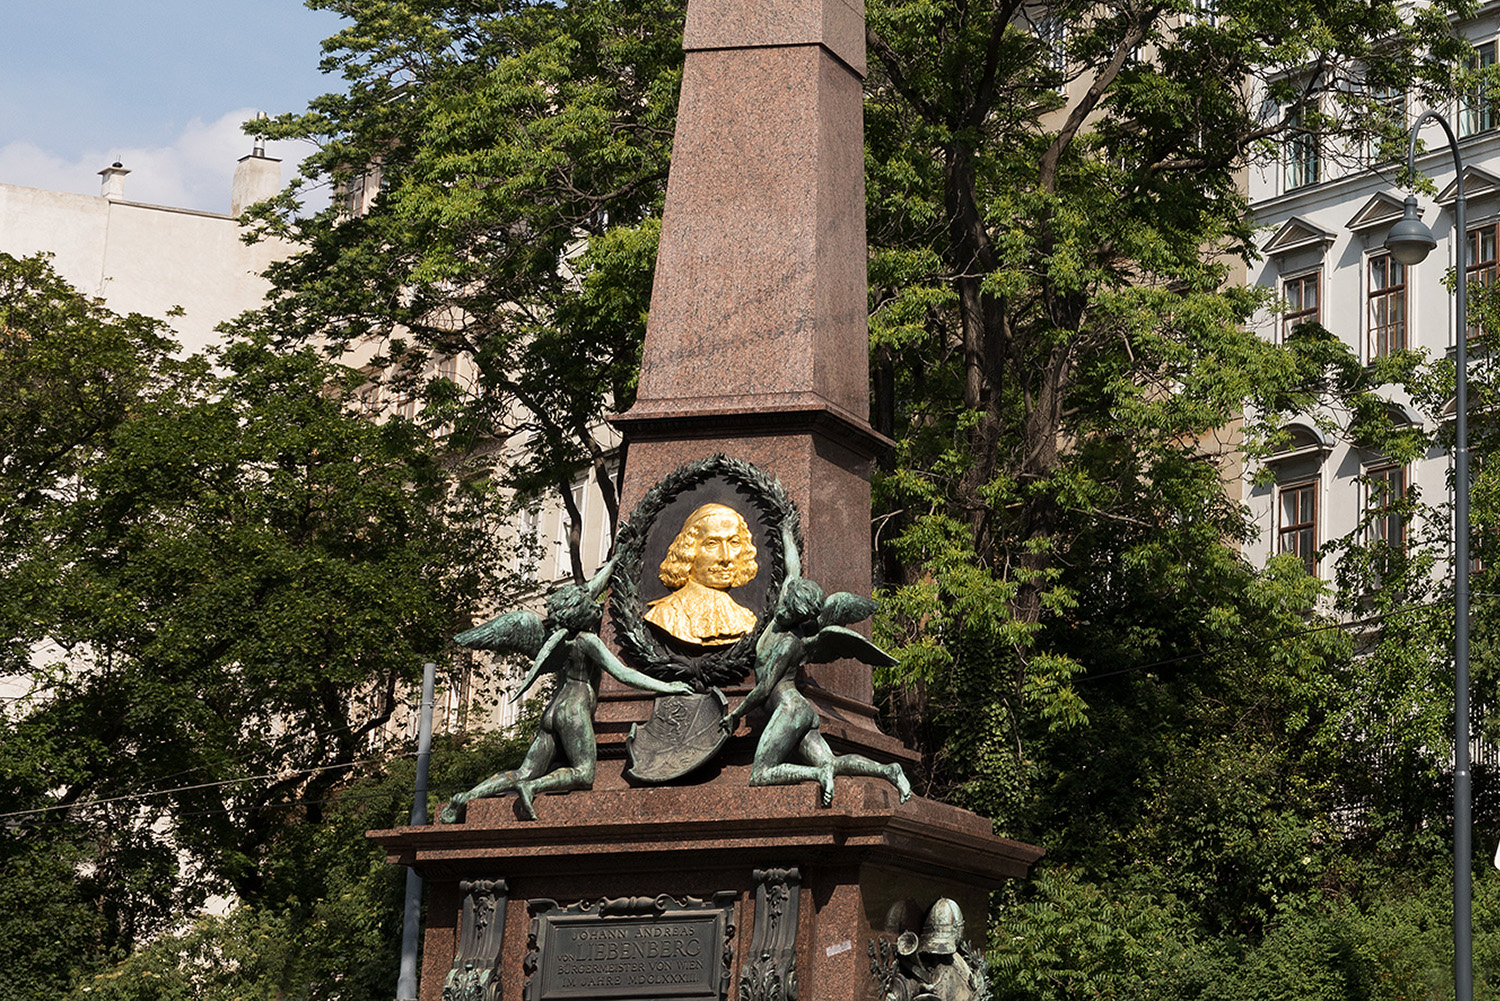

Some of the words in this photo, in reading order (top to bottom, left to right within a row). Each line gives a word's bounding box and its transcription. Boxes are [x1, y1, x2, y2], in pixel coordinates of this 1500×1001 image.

[571, 929, 627, 941] JOHANN
[635, 926, 695, 938] ANDREAS
[557, 954, 576, 962] VON
[577, 938, 701, 961] LIEBENBERG
[648, 961, 673, 972] VON
[676, 959, 705, 971] WIEN
[562, 976, 577, 988] IM
[580, 975, 622, 987] JAHRE
